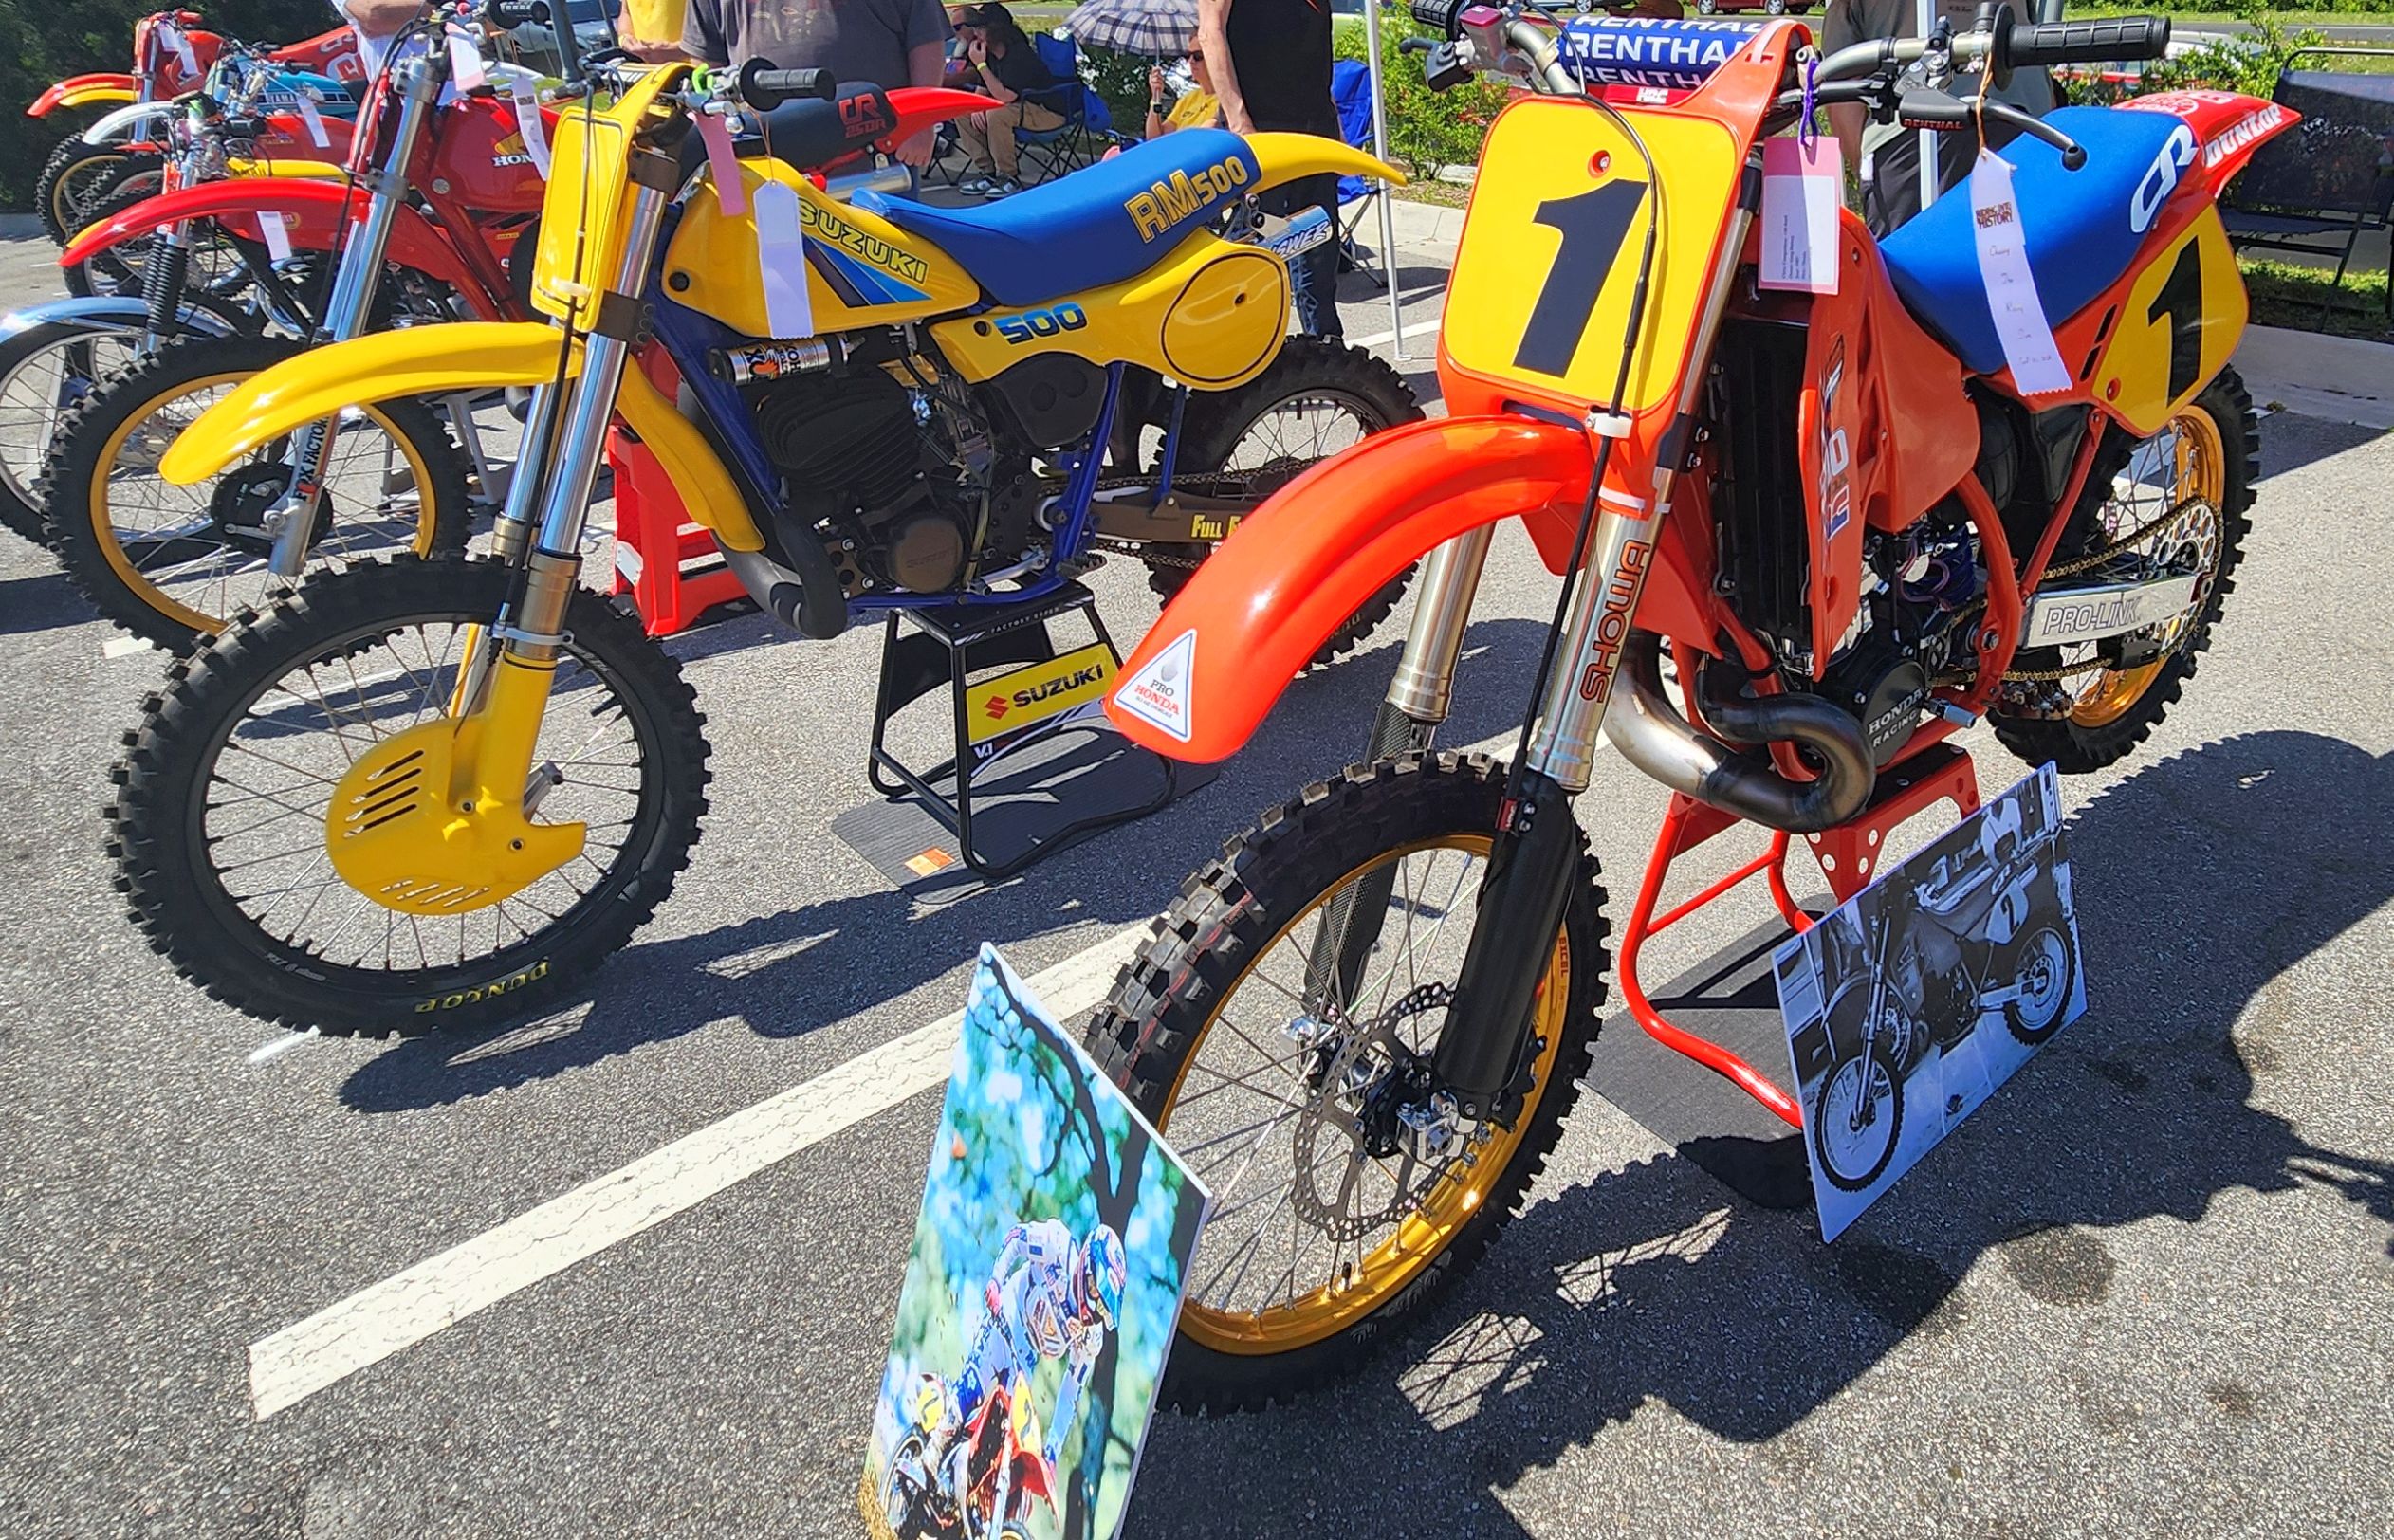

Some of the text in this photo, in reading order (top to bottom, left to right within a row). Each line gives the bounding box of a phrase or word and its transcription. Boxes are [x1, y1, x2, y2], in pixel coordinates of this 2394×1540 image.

[1565, 31, 1748, 65] RENTHA
[1569, 64, 1703, 89] RENTH
[838, 92, 882, 125] CR
[2204, 105, 2282, 168] DUNLOP
[492, 155, 534, 167] HON
[2130, 123, 2199, 229] CR
[1124, 156, 1249, 244] RM500
[798, 196, 929, 285] SUZUKI
[1512, 178, 1650, 379] 1
[993, 302, 1088, 346] 500
[2147, 234, 2203, 409] 1
[1579, 539, 1651, 704] SHOWA
[2042, 596, 2143, 636] PRO-LINK
[1012, 664, 1105, 708] SUZUKI
[1133, 684, 1180, 715] HONDA
[1150, 678, 1175, 698] PRO
[1867, 687, 1924, 736] HONDA
[1872, 708, 1917, 747] RACING
[413, 961, 550, 1014] DUNLOP
